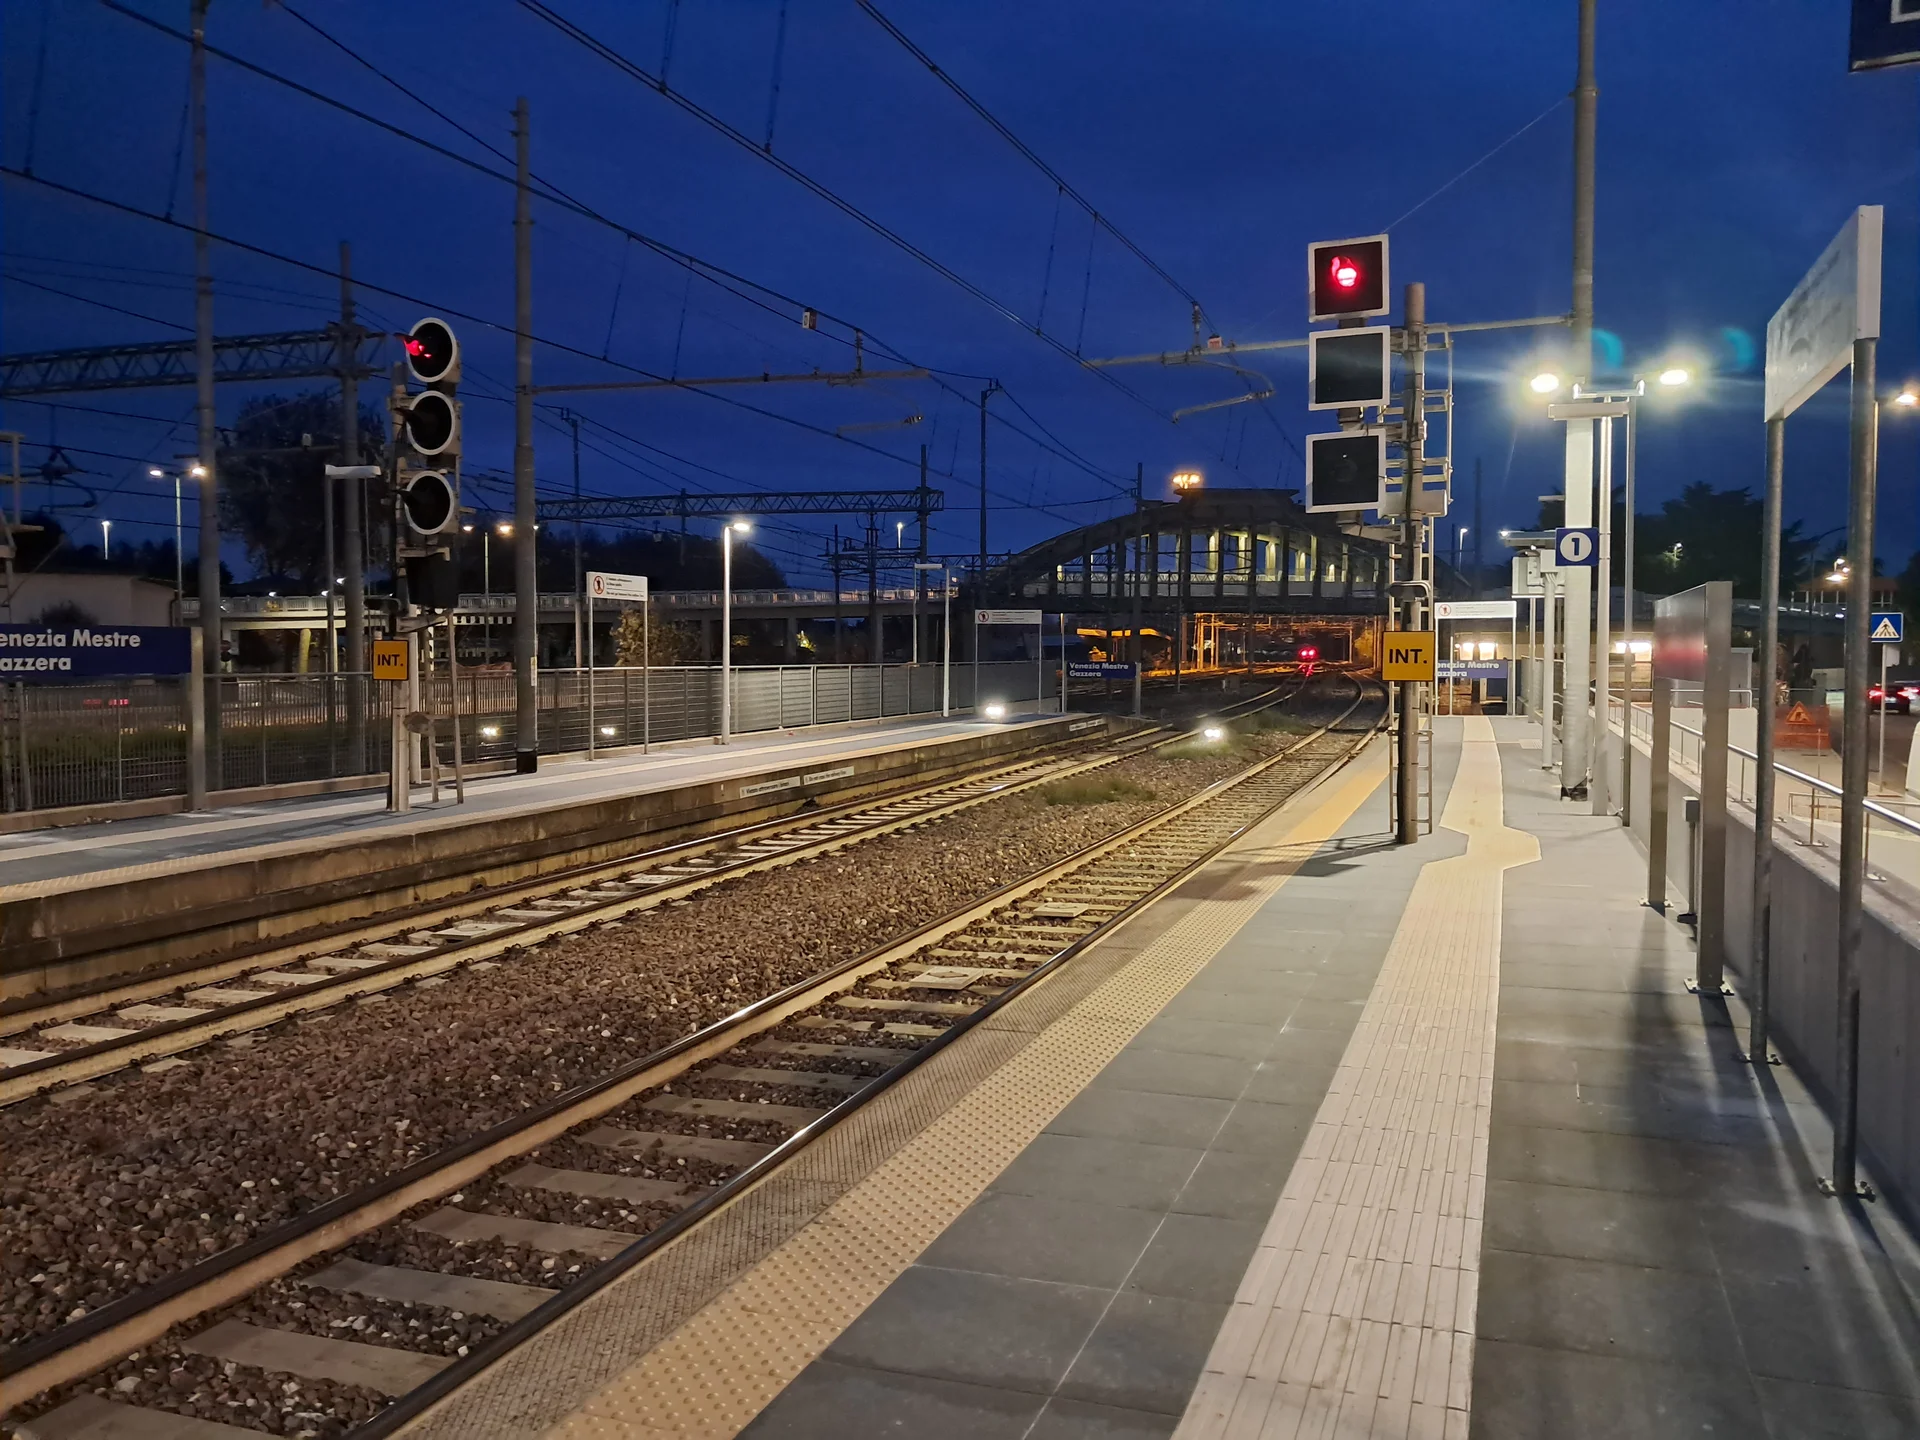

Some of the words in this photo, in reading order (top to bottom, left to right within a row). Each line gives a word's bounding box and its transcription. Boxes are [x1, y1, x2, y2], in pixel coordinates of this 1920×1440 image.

[1571, 537, 1580, 556] 1
[0, 628, 66, 647] enezia
[72, 628, 141, 647] Mestre
[377, 653, 404, 667] INT.
[1388, 648, 1428, 664] INT.
[0, 657, 72, 671] azzera
[1069, 661, 1101, 670] Venezia
[1101, 662, 1129, 670] Mestre
[1437, 661, 1466, 669] enezia
[1467, 661, 1500, 669] Mestre
